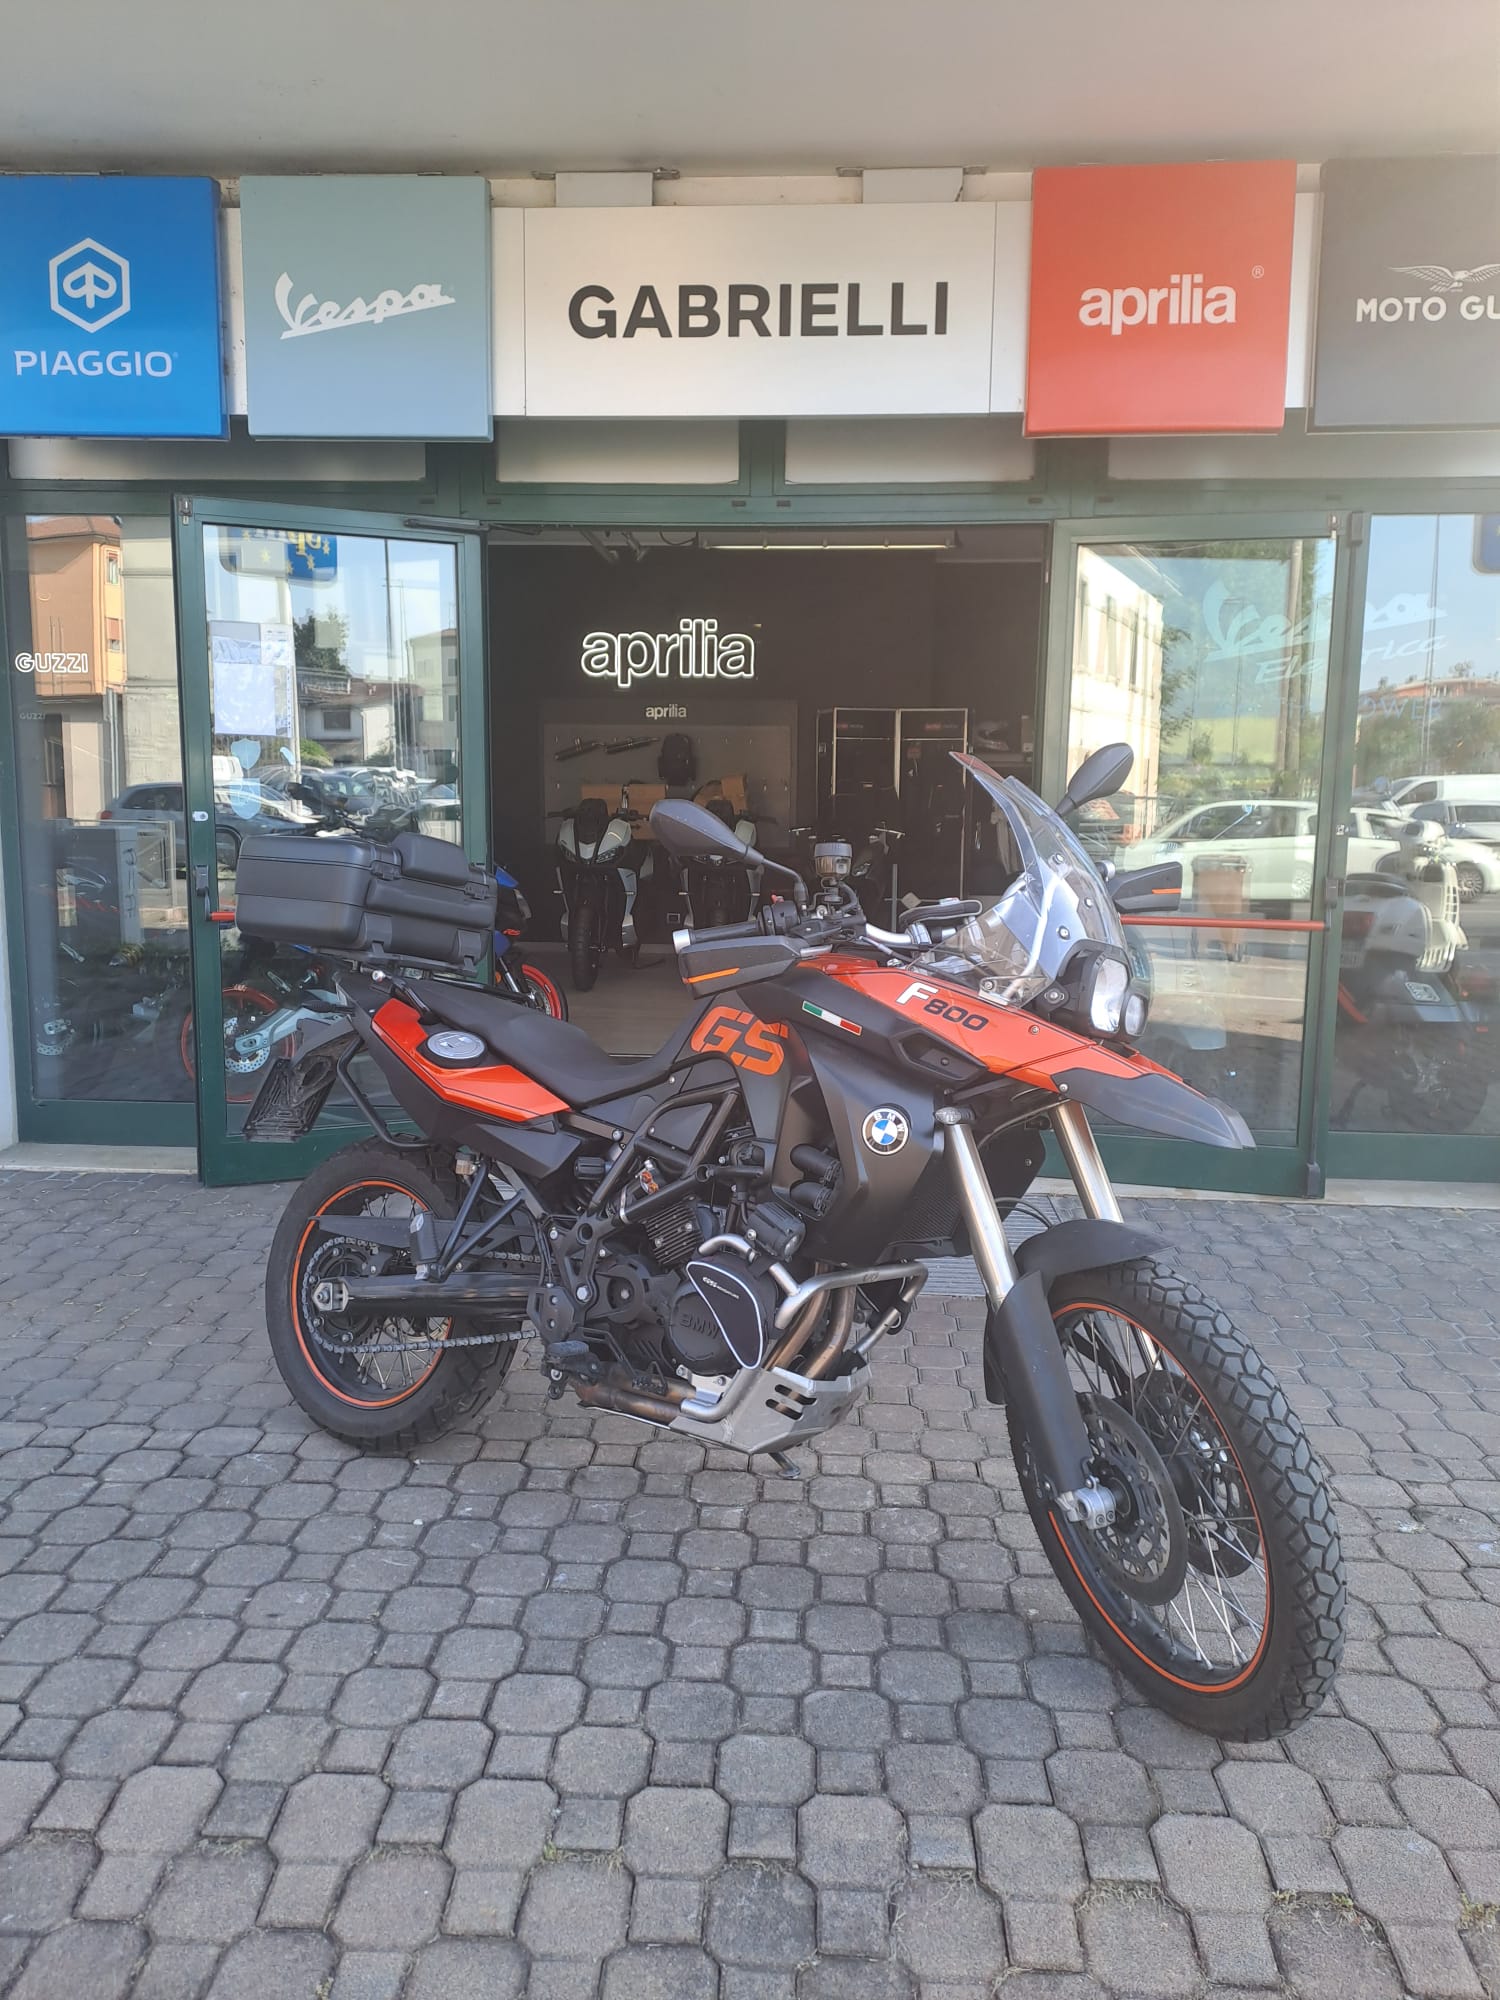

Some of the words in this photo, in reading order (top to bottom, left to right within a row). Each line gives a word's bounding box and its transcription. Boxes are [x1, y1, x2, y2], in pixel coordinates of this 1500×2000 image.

[275, 271, 456, 340] Vespa
[568, 282, 949, 339] GABRIELLI
[1078, 274, 1237, 335] aprilia
[1356, 296, 1447, 322] MOTO
[14, 350, 173, 377] PIAGGIO
[15, 652, 89, 673] GUZZI
[580, 618, 755, 688] aprilia
[645, 704, 687, 720] aprilia
[923, 999, 988, 1031] 800
[690, 1006, 789, 1076] GS
